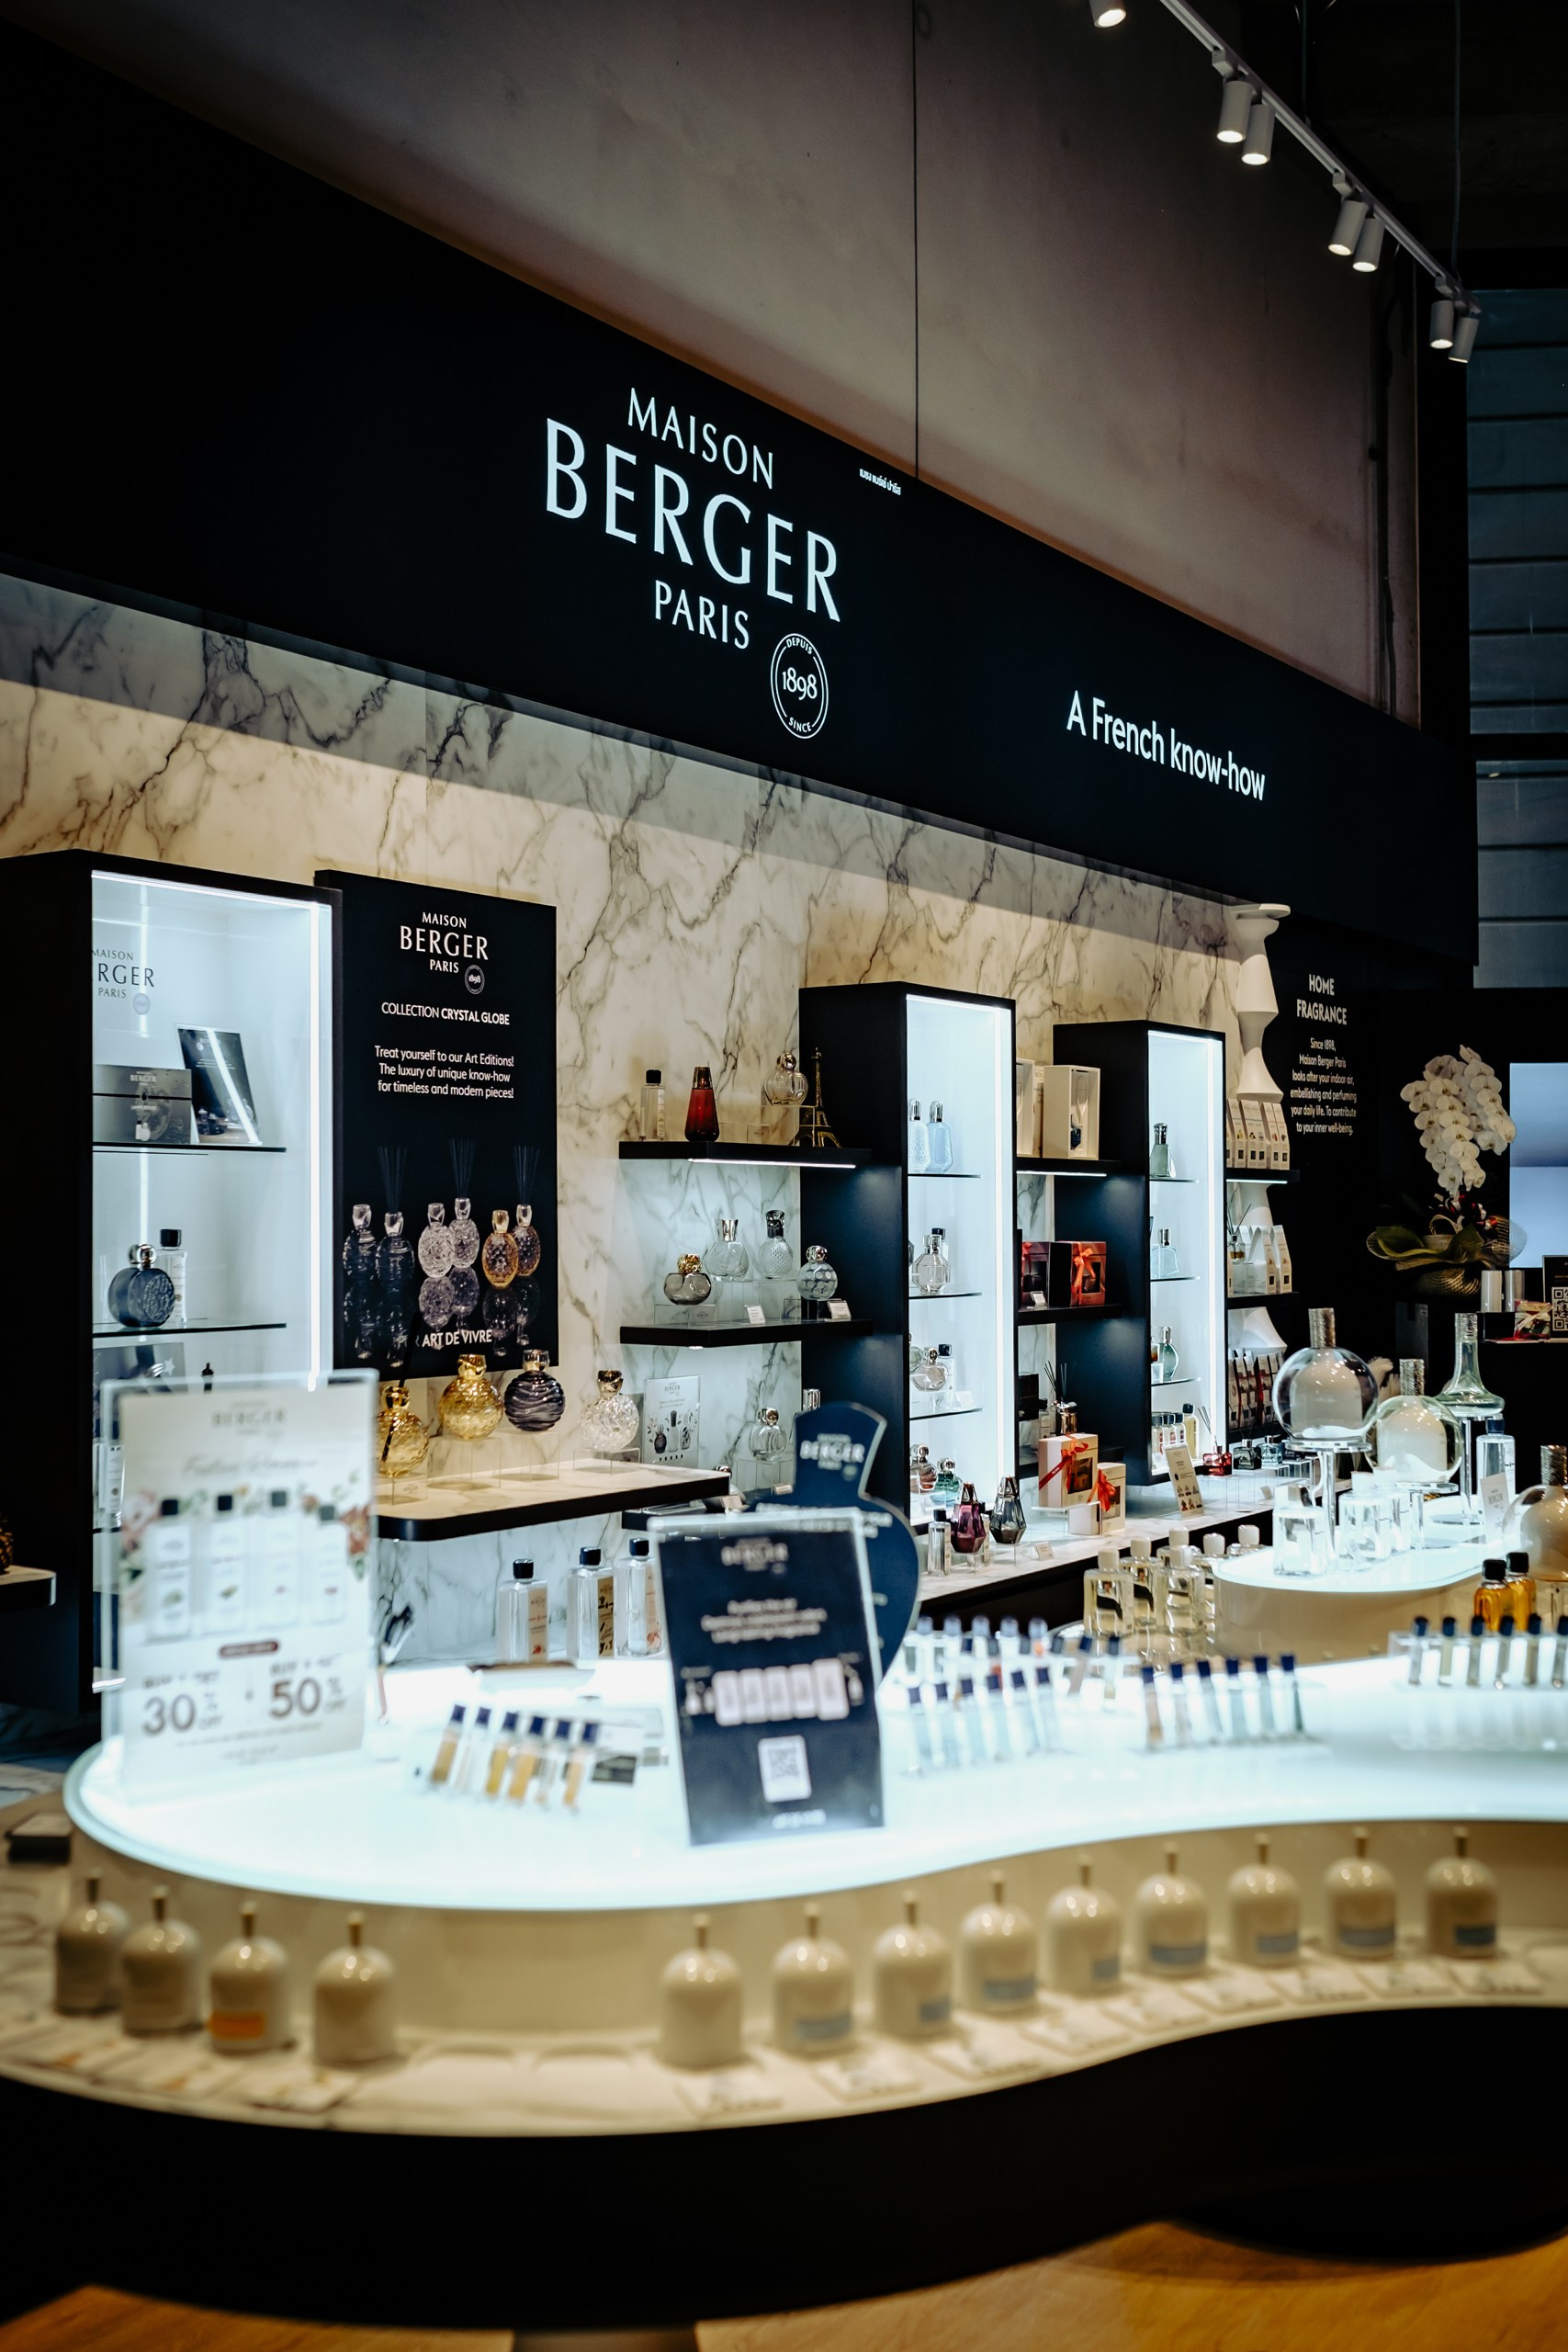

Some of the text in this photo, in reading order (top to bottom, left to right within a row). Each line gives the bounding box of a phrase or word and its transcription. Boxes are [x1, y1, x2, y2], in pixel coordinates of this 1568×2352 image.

[628, 387, 773, 490] MAISON
[547, 417, 840, 622] BERGER
[655, 580, 750, 649] PARIS
[786, 637, 813, 655] DEPUIS
[782, 667, 818, 700] 1898
[788, 717, 812, 732] SINCE
[1066, 690, 1266, 801] A French know-how
[422, 911, 467, 929] MAISON
[400, 925, 489, 961] BERGER
[92, 948, 133, 961] MAISON
[98, 963, 154, 988] RGER
[430, 958, 459, 974] PARIS
[98, 988, 127, 999] PARIS
[1308, 973, 1335, 996] HOME
[381, 1001, 510, 1025] COLLECTION CRYSTAL GLOBE
[1296, 999, 1348, 1025] FRAGRANCE
[1310, 1036, 1324, 1049] Since
[374, 1046, 514, 1067] Treat yourself to our Art Editions!
[1299, 1053, 1347, 1069] Maison Berger Paris
[378, 1062, 511, 1082] The luxury of unique know-how
[1292, 1069, 1306, 1081] looks
[1306, 1070, 1318, 1082] after
[1318, 1074, 1330, 1085] your
[1330, 1072, 1347, 1084] indoor
[378, 1080, 514, 1100] for timeless and modern pieces!
[1290, 1087, 1358, 1103] embellishing and perfuming
[1291, 1106, 1303, 1117] your
[1303, 1104, 1315, 1118] daily
[1315, 1104, 1325, 1116] life.
[1325, 1105, 1332, 1116] To
[1332, 1106, 1357, 1117] contribute
[1296, 1122, 1303, 1133] to
[1303, 1124, 1314, 1136] your
[1314, 1122, 1327, 1133] inner
[422, 1329, 492, 1348] ART DE VIVRE
[269, 1678, 321, 1719] 50
[142, 1694, 197, 1736] 30
